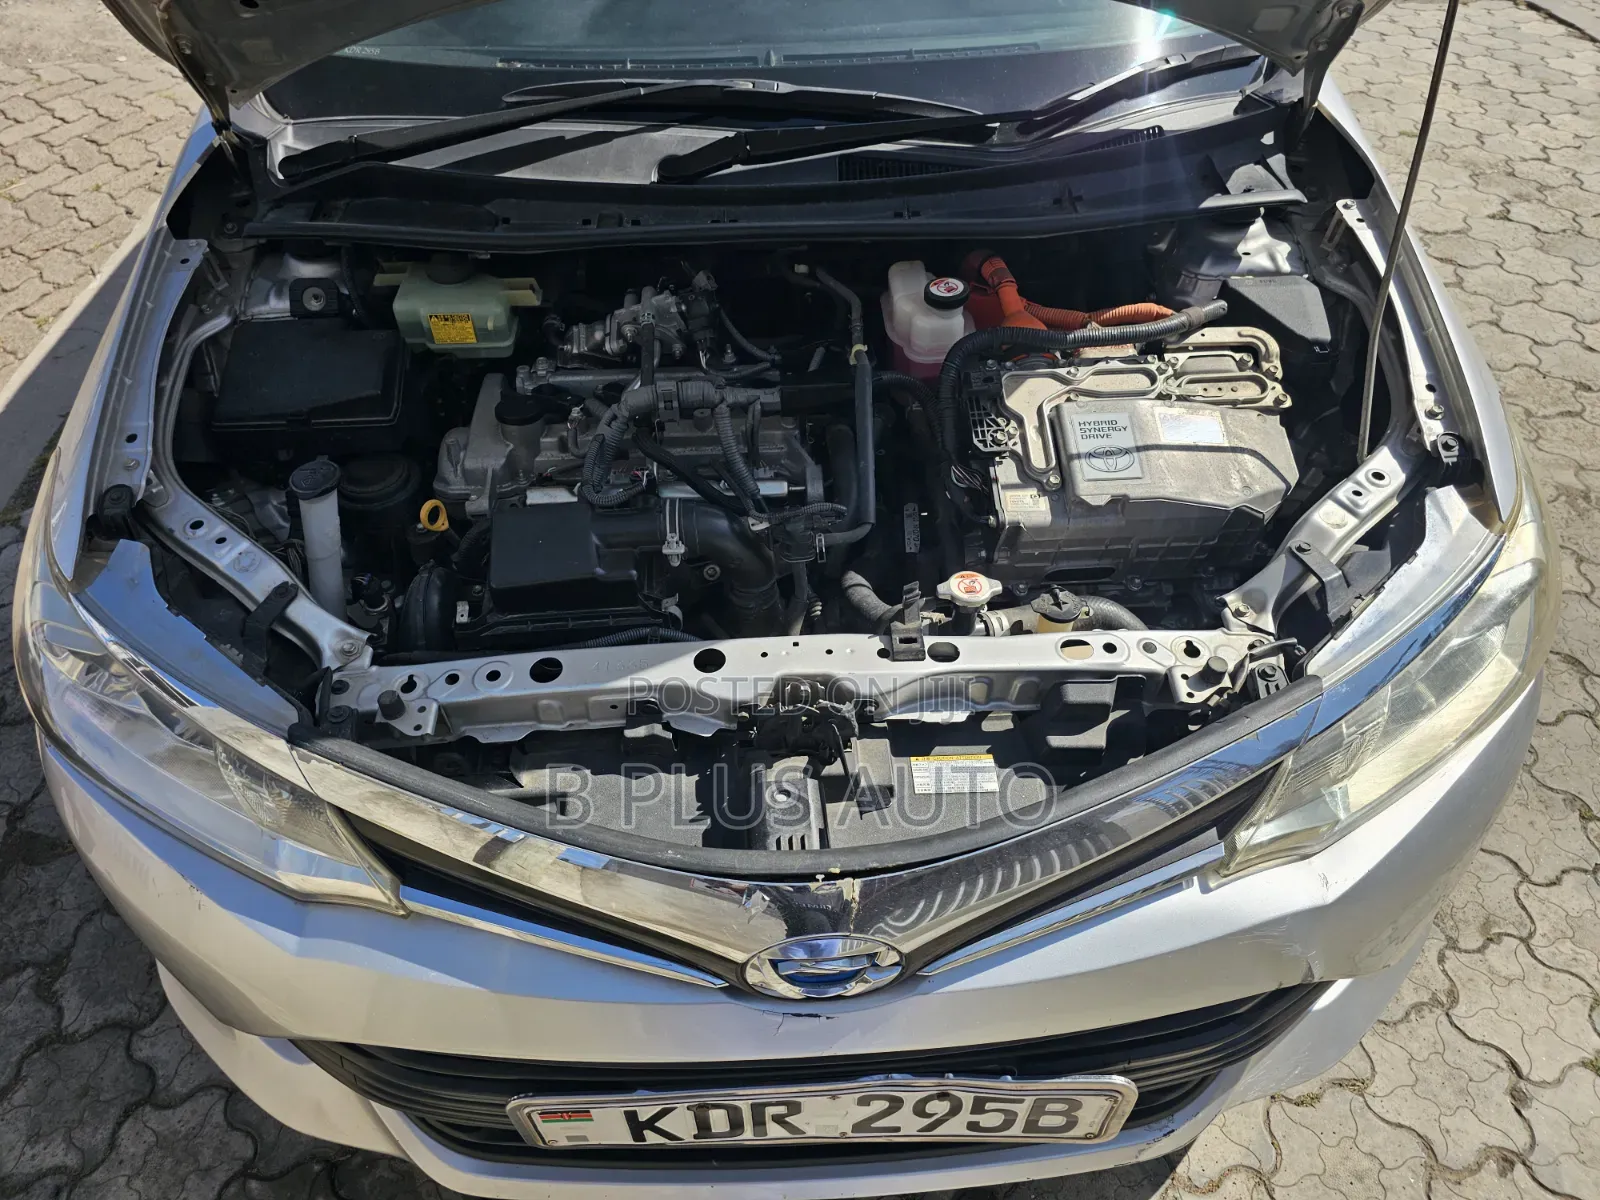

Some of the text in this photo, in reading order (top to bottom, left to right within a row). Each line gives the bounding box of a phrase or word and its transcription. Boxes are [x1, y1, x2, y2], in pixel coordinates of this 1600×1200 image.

[1079, 426, 1128, 434] SYNERGY
[623, 1100, 806, 1142] KDR
[851, 1092, 1083, 1134] 295B
